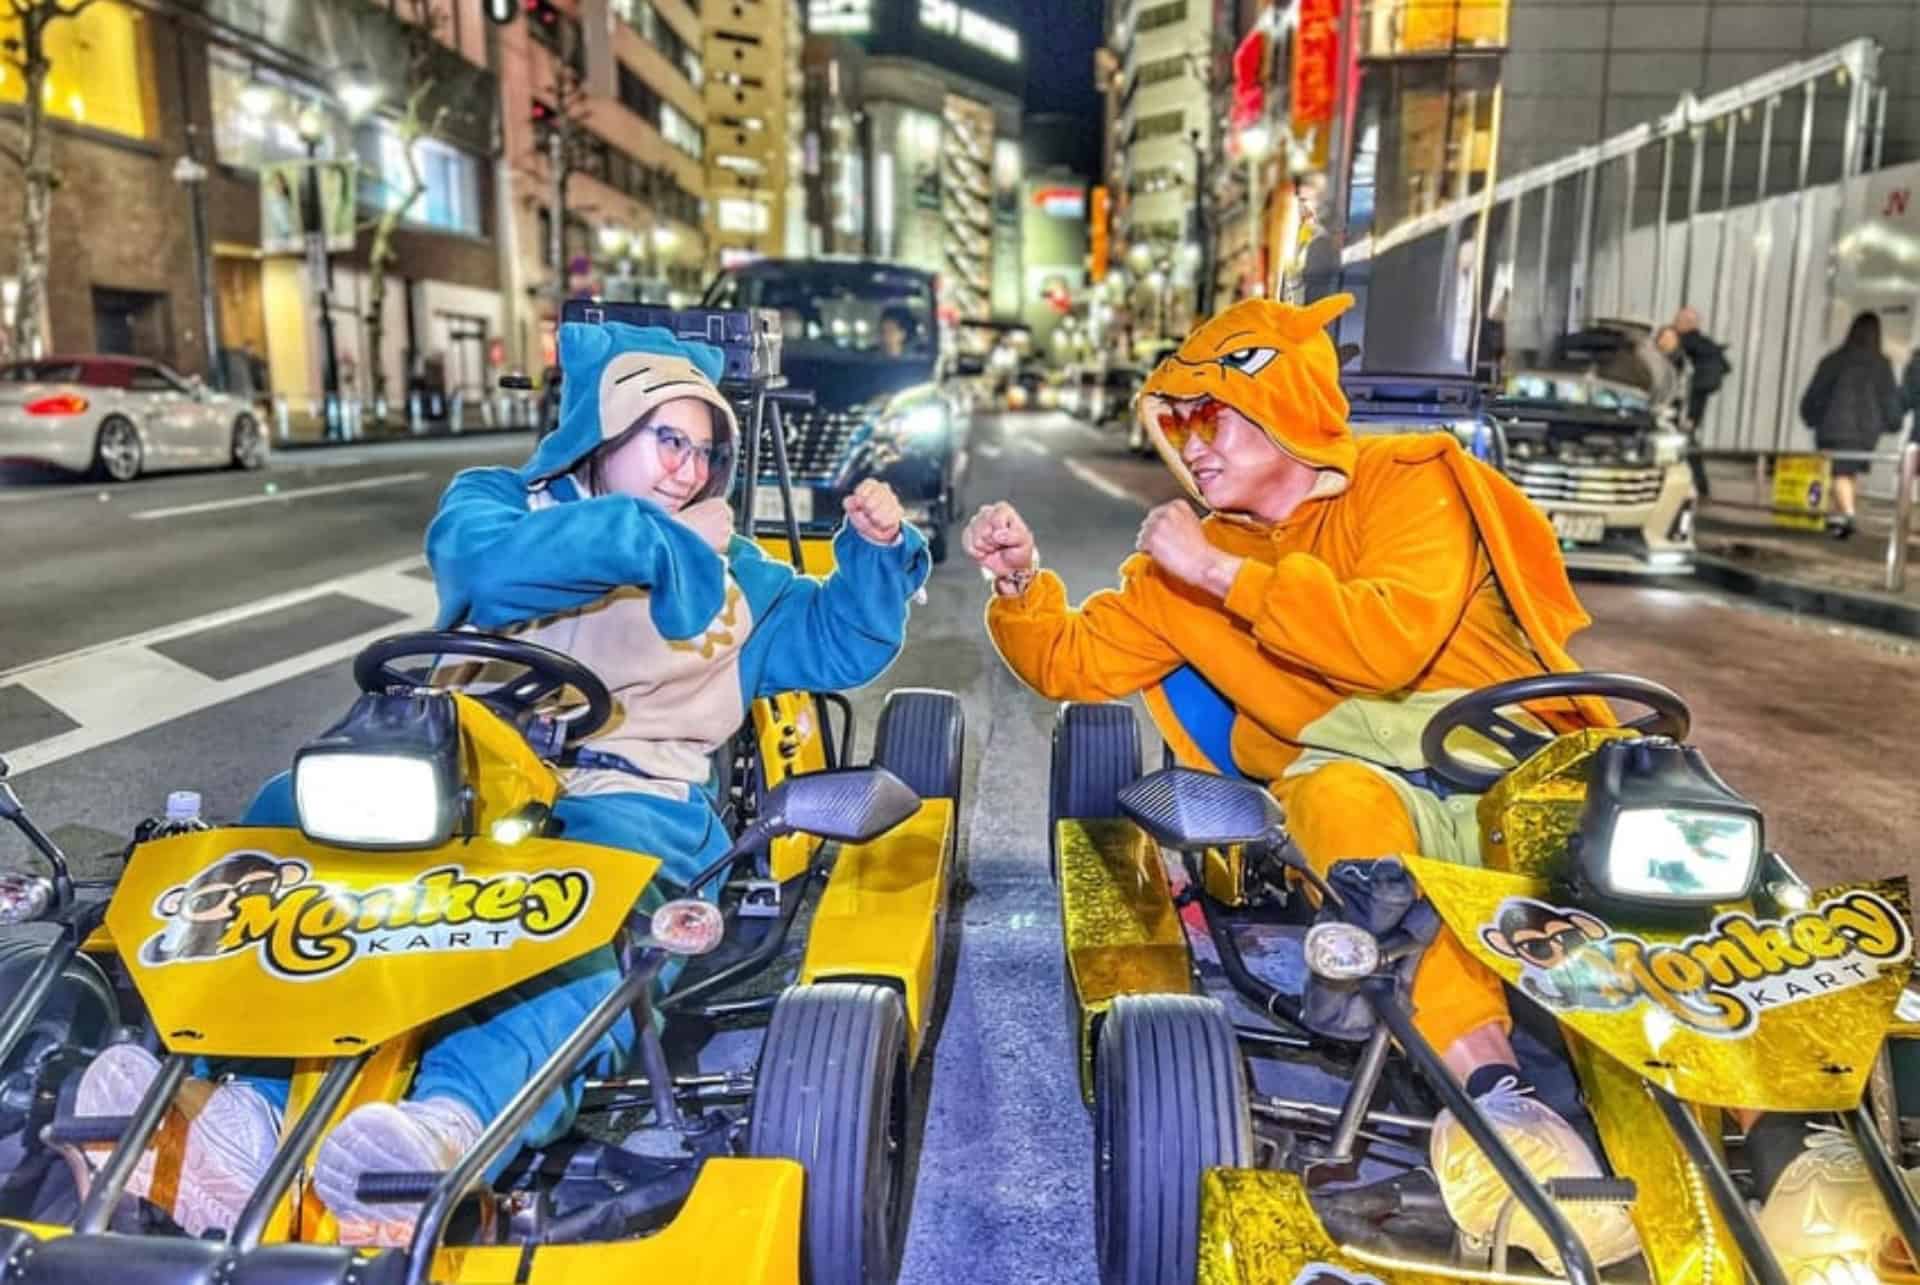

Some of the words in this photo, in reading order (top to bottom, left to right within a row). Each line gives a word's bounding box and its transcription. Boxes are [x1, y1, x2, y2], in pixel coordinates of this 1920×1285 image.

[220, 868, 590, 976] Monkey
[368, 929, 509, 953] KART
[1578, 893, 1902, 1032] Monkey
[1750, 962, 1867, 1005] KART
